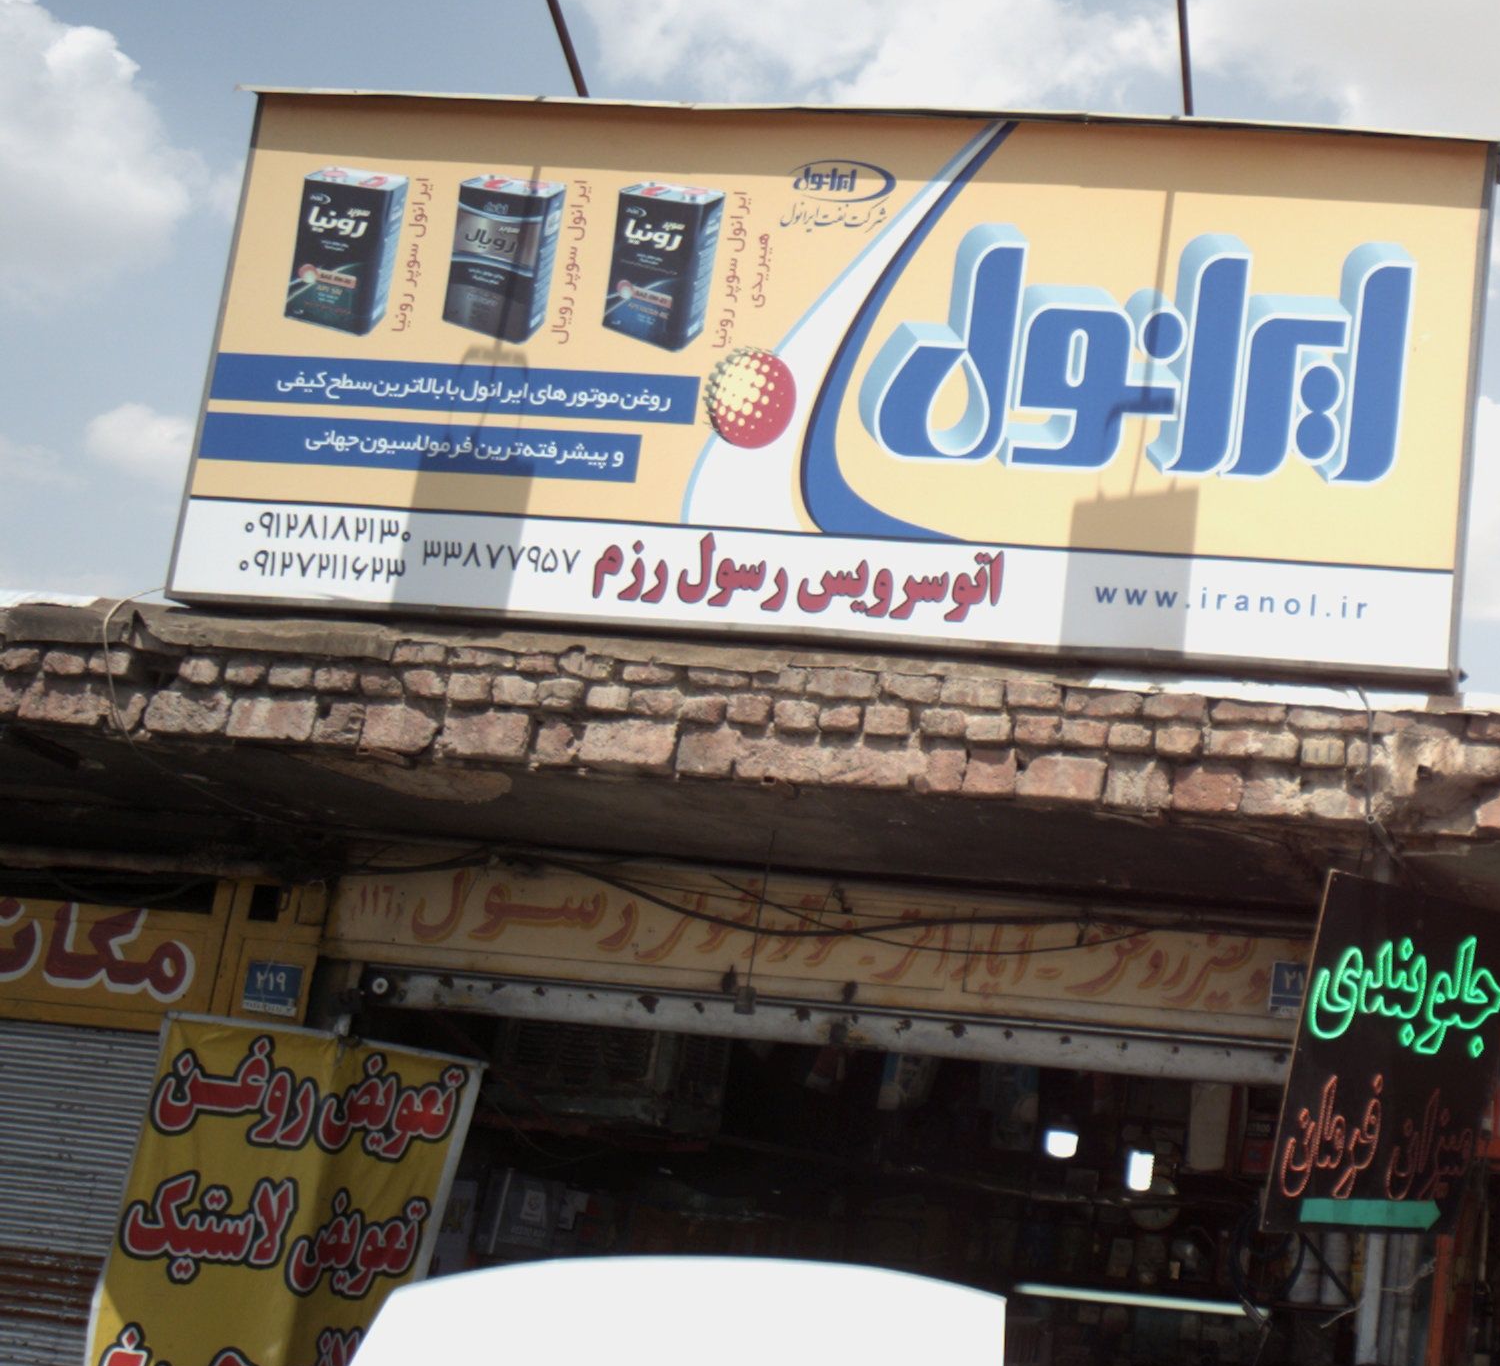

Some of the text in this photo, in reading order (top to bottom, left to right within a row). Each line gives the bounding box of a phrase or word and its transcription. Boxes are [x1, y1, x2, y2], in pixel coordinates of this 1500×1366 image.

[308, 205, 368, 238] رونیا
[624, 218, 683, 252] رونیا
[391, 178, 433, 333] ایرانول سوپر رونیا
[465, 228, 517, 253] رویال
[551, 180, 592, 345] ایرانول سوپر رویال
[712, 192, 752, 348] ایرانول سوپر رونیا
[752, 233, 773, 308] هیبریدی
[859, 223, 1415, 487] ایرانول
[277, 371, 328, 393] کیفی
[325, 373, 373, 399] سطح
[373, 377, 445, 399] بالاترین
[446, 379, 459, 400] با
[460, 379, 529, 404] ایرانول
[619, 388, 672, 411] روغن
[304, 429, 360, 452] جهانی
[360, 434, 473, 459] فرمولاسیون
[612, 450, 625, 467] و
[244, 511, 412, 545] ۰۹۱۲۸۱۸۲۱۳۰
[239, 550, 407, 584] ۰۹۱۲۷۲۱۱۶۲۳
[422, 539, 581, 575] ۳۳۸۷۷۹۵۷
[592, 538, 670, 605] رزم
[676, 531, 790, 613] رسول
[1094, 585, 1369, 620] www.iranol.ir
[410, 866, 640, 953] رسول
[255, 970, 288, 993] ۲۱۹
[151, 1035, 469, 1159] تعویض روغن
[1280, 1073, 1384, 1199] فرمان
[119, 1171, 431, 1299] تعویض لاستیک
